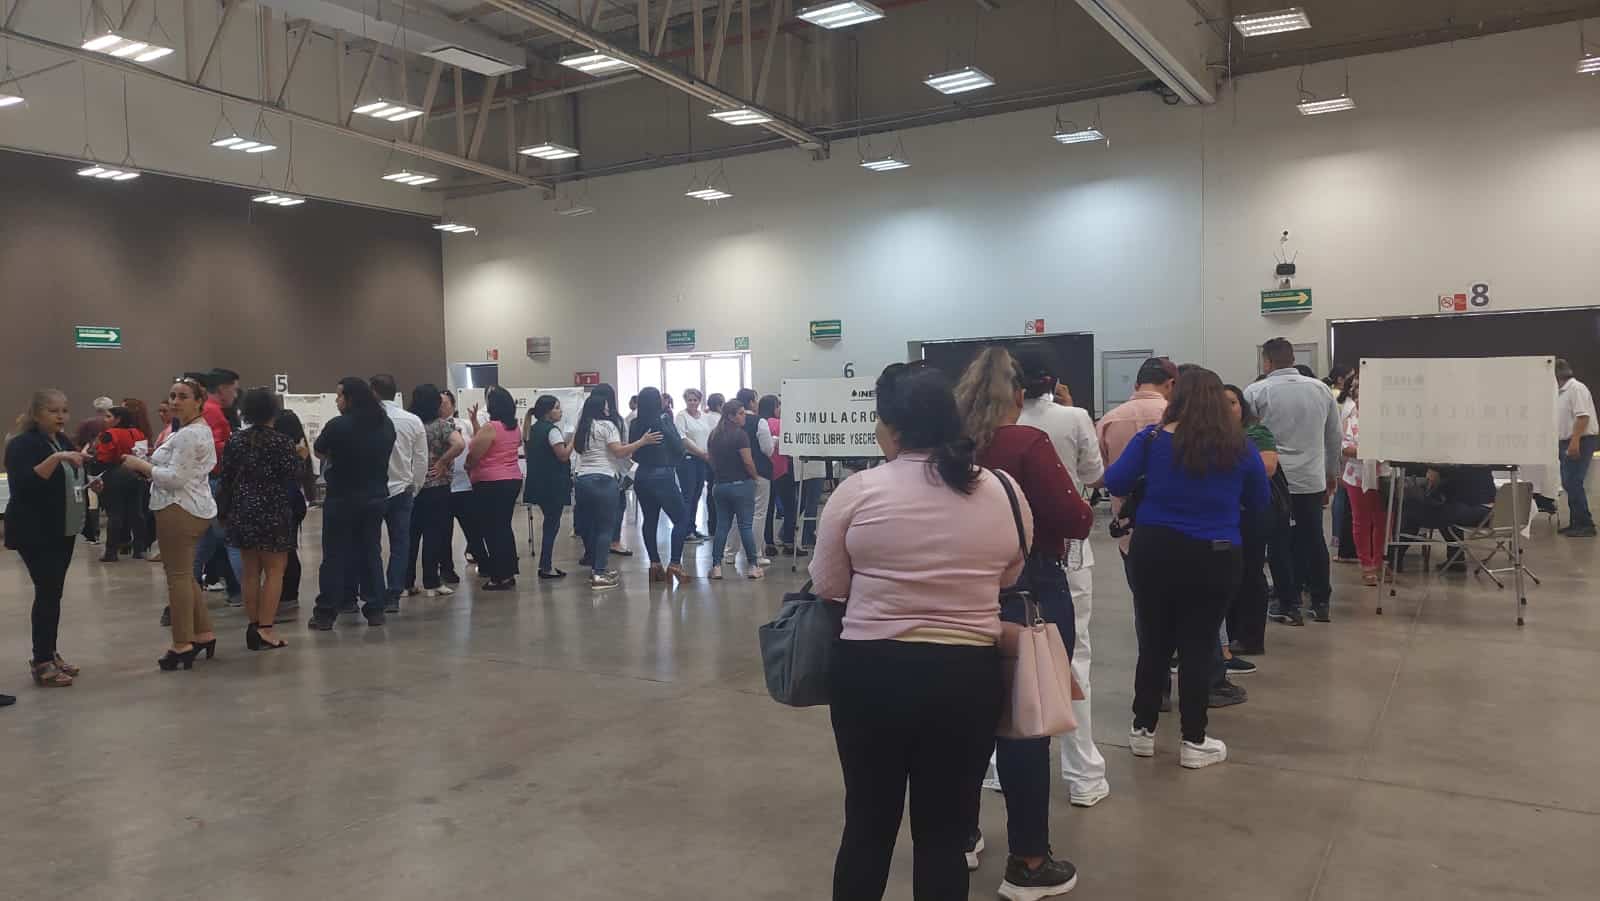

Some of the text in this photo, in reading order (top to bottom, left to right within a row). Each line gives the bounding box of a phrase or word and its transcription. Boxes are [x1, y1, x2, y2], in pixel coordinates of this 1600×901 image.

[1471, 284, 1489, 306] 8
[844, 362, 854, 378] 6
[277, 376, 287, 392] 5
[796, 411, 877, 424] SIMULACRO
[783, 432, 793, 444] EL
[823, 432, 846, 445] LIBRE
